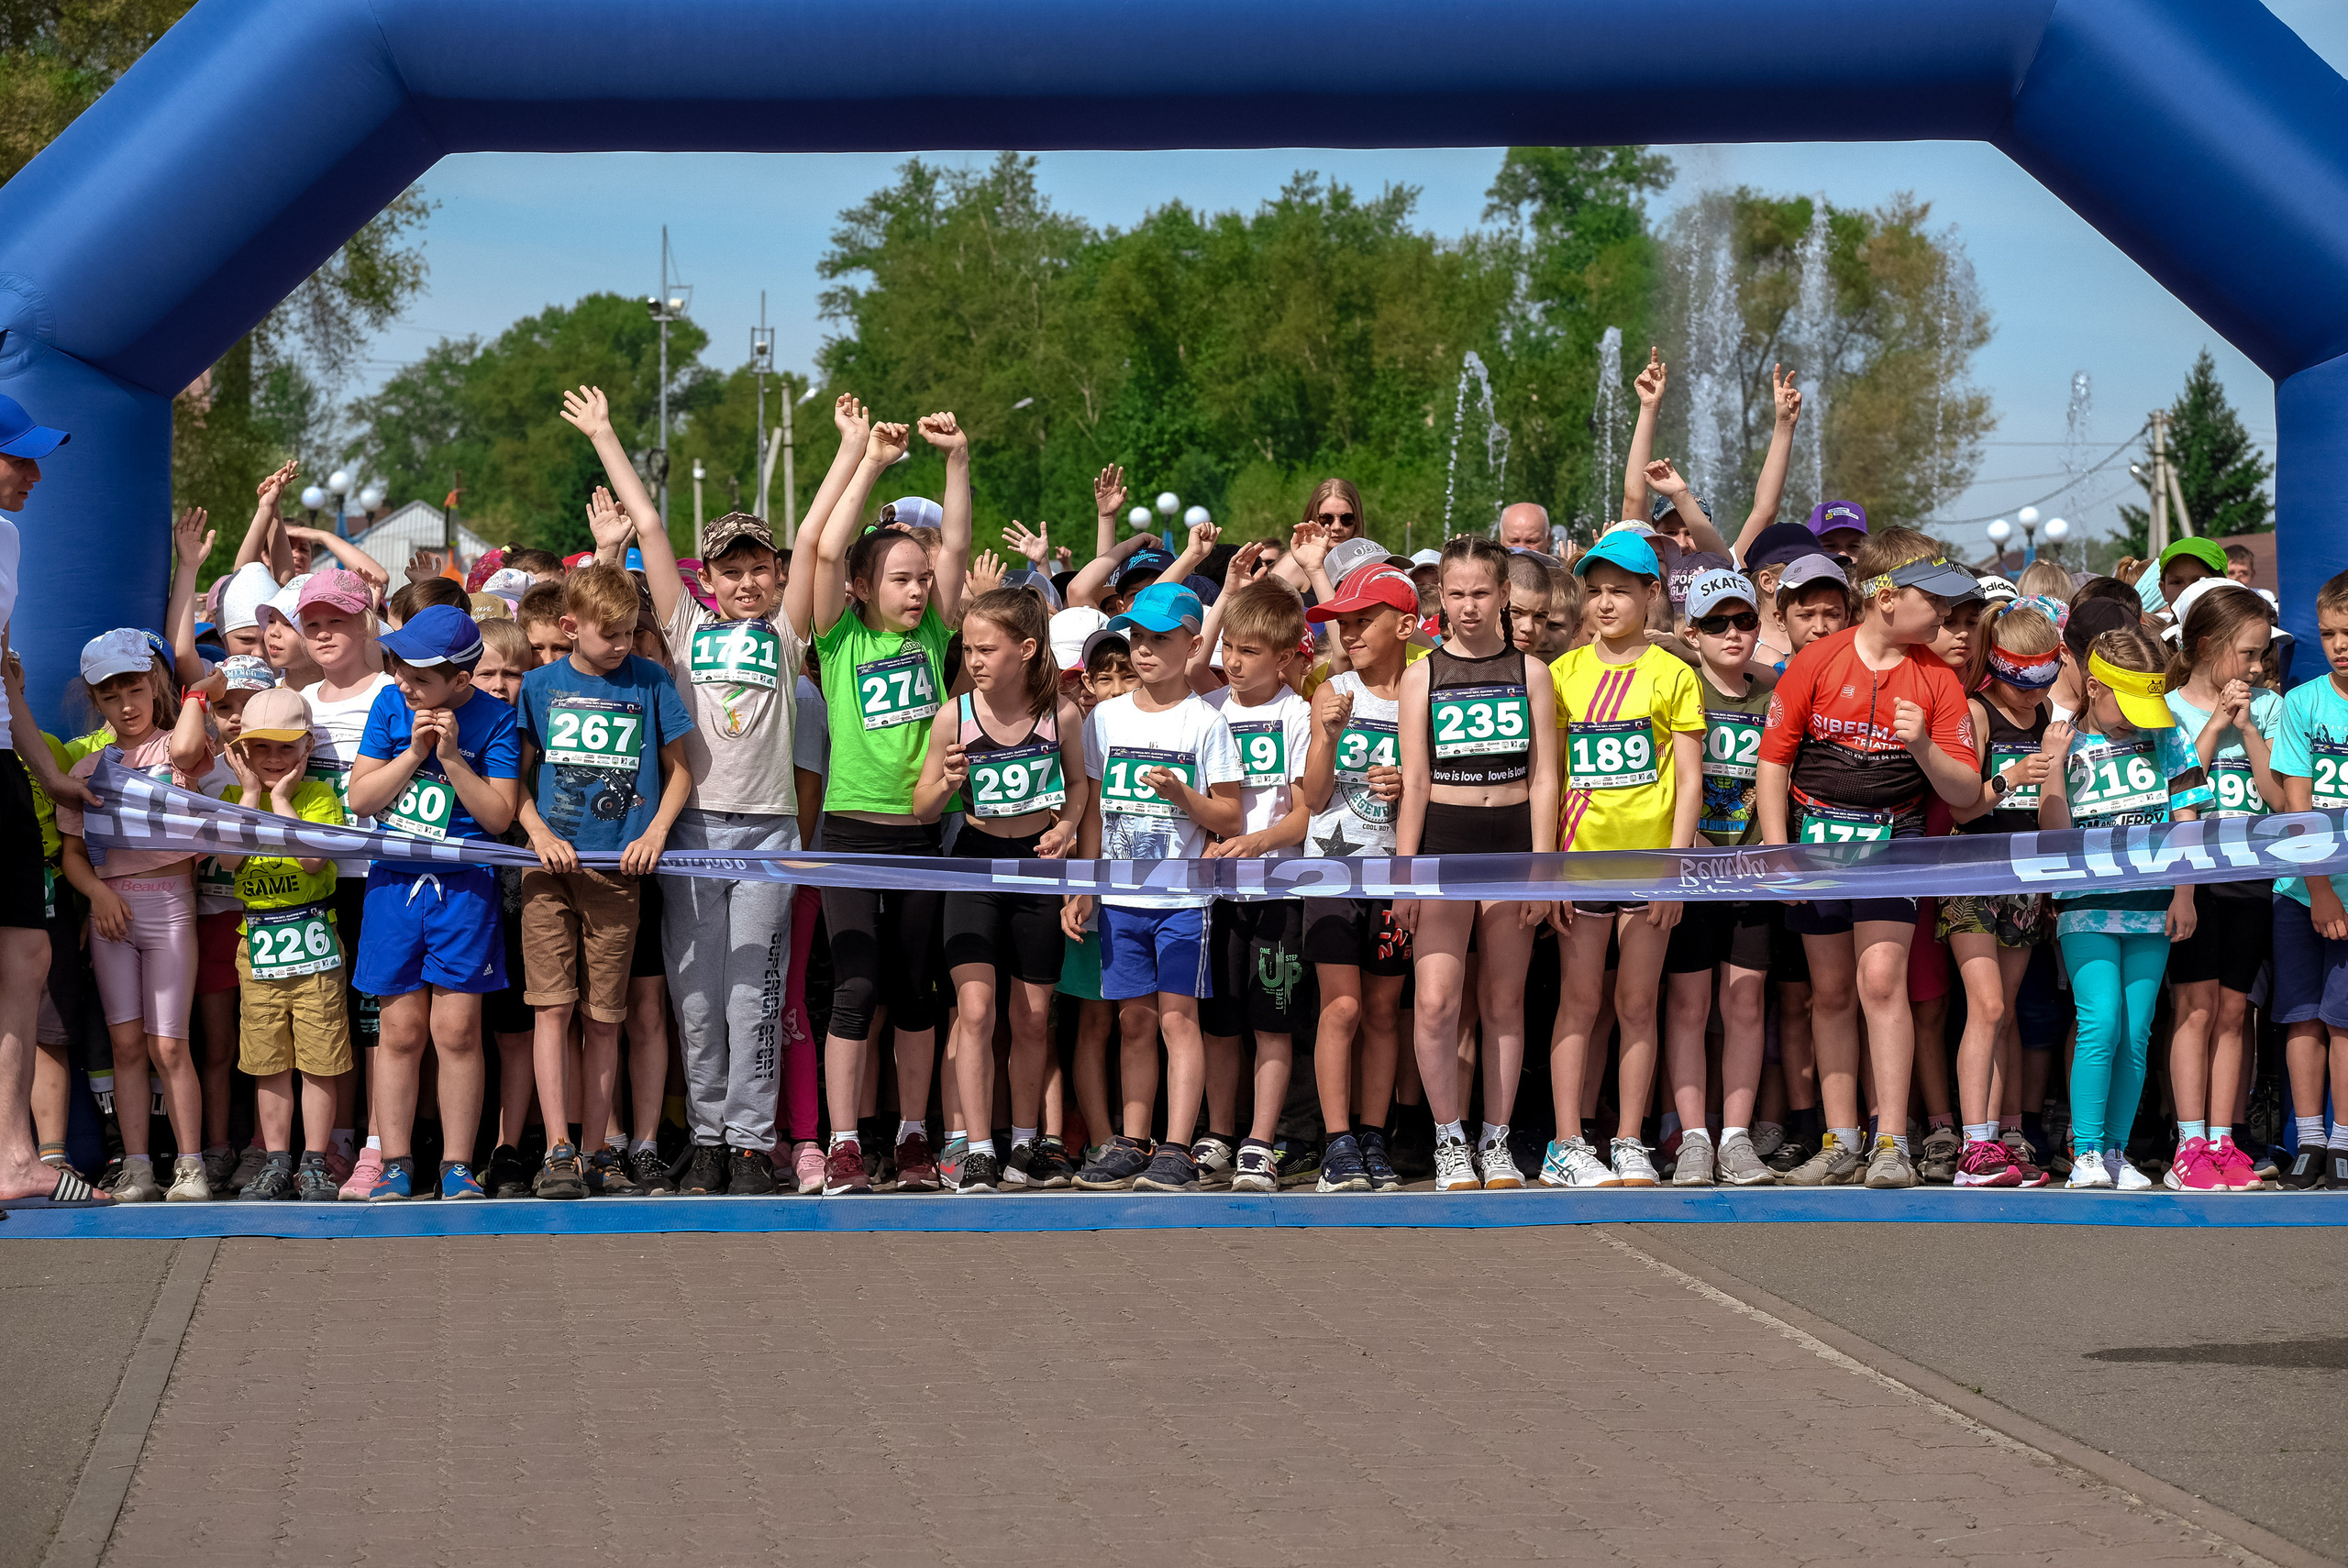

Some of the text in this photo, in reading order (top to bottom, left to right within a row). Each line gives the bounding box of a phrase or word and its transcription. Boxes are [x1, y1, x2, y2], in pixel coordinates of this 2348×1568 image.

[1669, 572, 1698, 586] SPOR
[1700, 577, 1748, 597] SKATE
[694, 635, 777, 670] 1721
[862, 667, 933, 713] 274
[550, 712, 637, 753] 267
[1437, 701, 1523, 742] 235
[1340, 733, 1397, 768] 34
[1573, 734, 1650, 773] 189
[975, 757, 1053, 801] 297
[1434, 768, 1450, 780] love
[1451, 770, 1459, 780] is
[1461, 771, 1483, 781] love
[1488, 770, 1507, 781] love
[1507, 767, 1514, 778] is
[2069, 756, 2156, 803] 216
[120, 879, 177, 892] Beauty
[243, 874, 300, 897] GAME
[252, 921, 331, 965] 226
[1285, 954, 1299, 962] STEP
[1275, 987, 1284, 1010] LEVEL
[755, 1024, 776, 1080] SPORT
